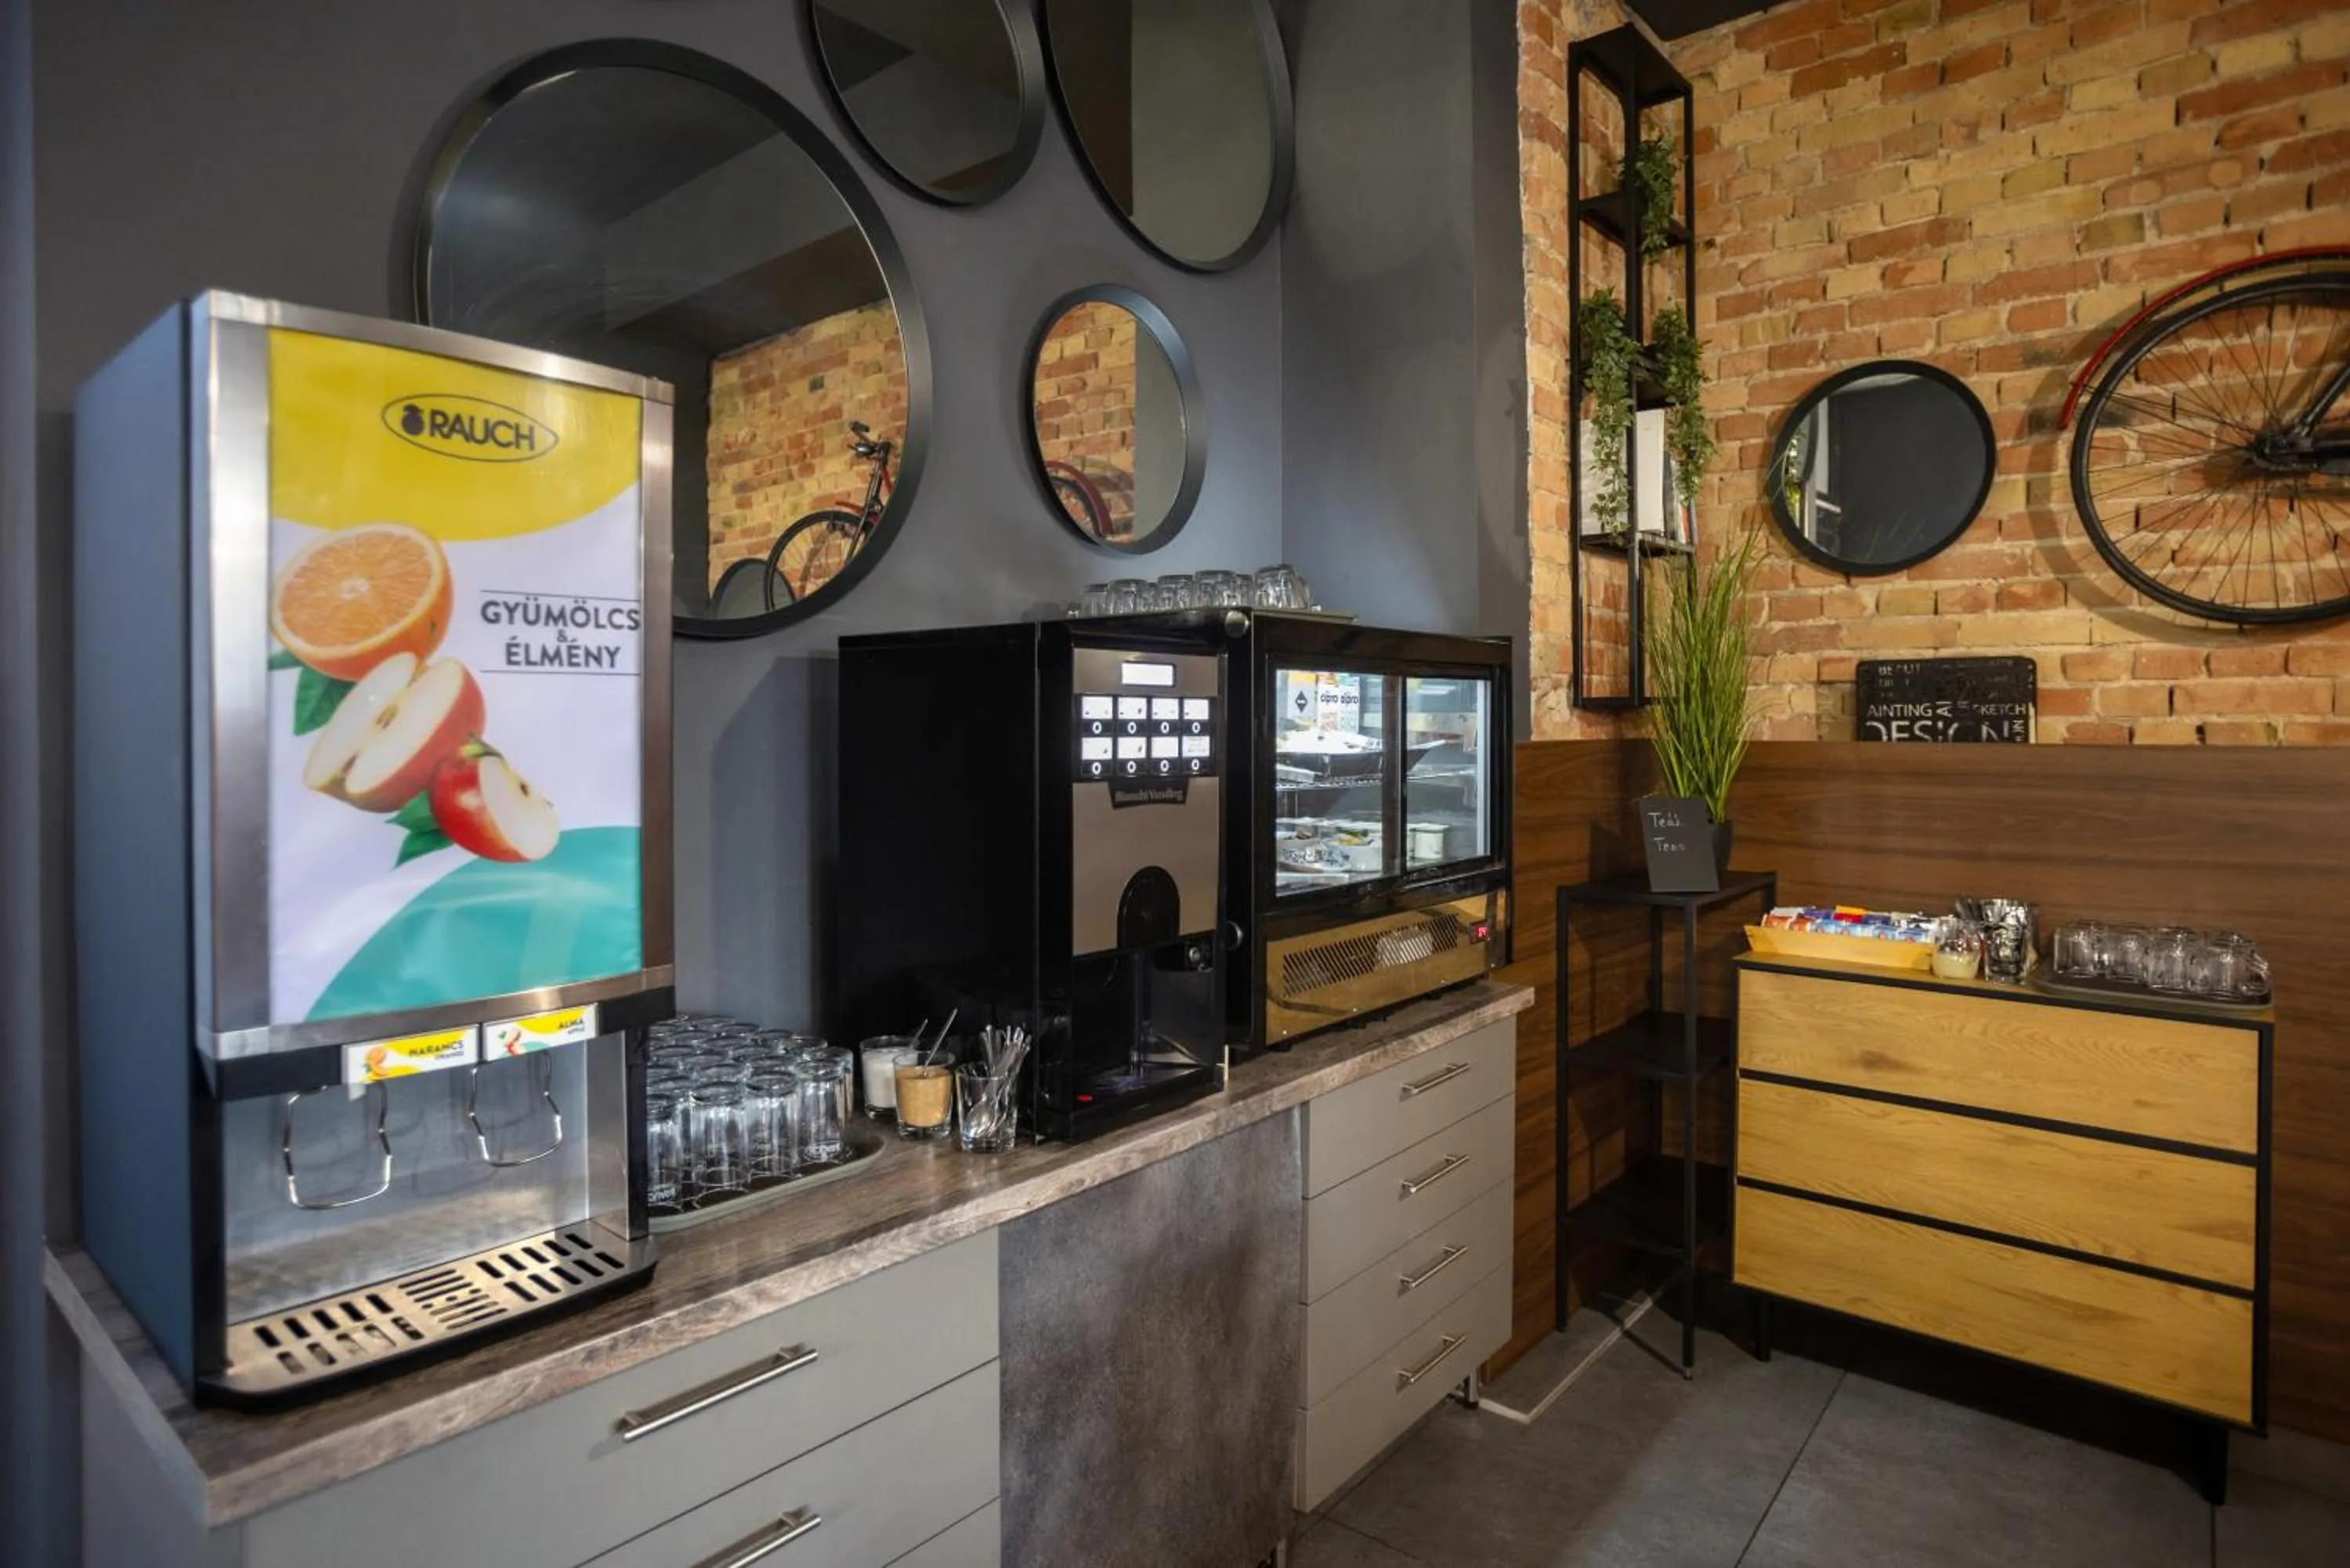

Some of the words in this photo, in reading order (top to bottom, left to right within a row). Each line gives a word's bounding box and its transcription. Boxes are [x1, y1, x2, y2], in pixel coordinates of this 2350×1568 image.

[428, 408, 535, 451] RAUCH
[480, 596, 640, 631] GYÜMÖLCS
[555, 629, 568, 643] &
[504, 637, 621, 668] ÉLMÉNY
[557, 1018, 584, 1030] ALMA
[408, 1039, 464, 1057] NARANCS
